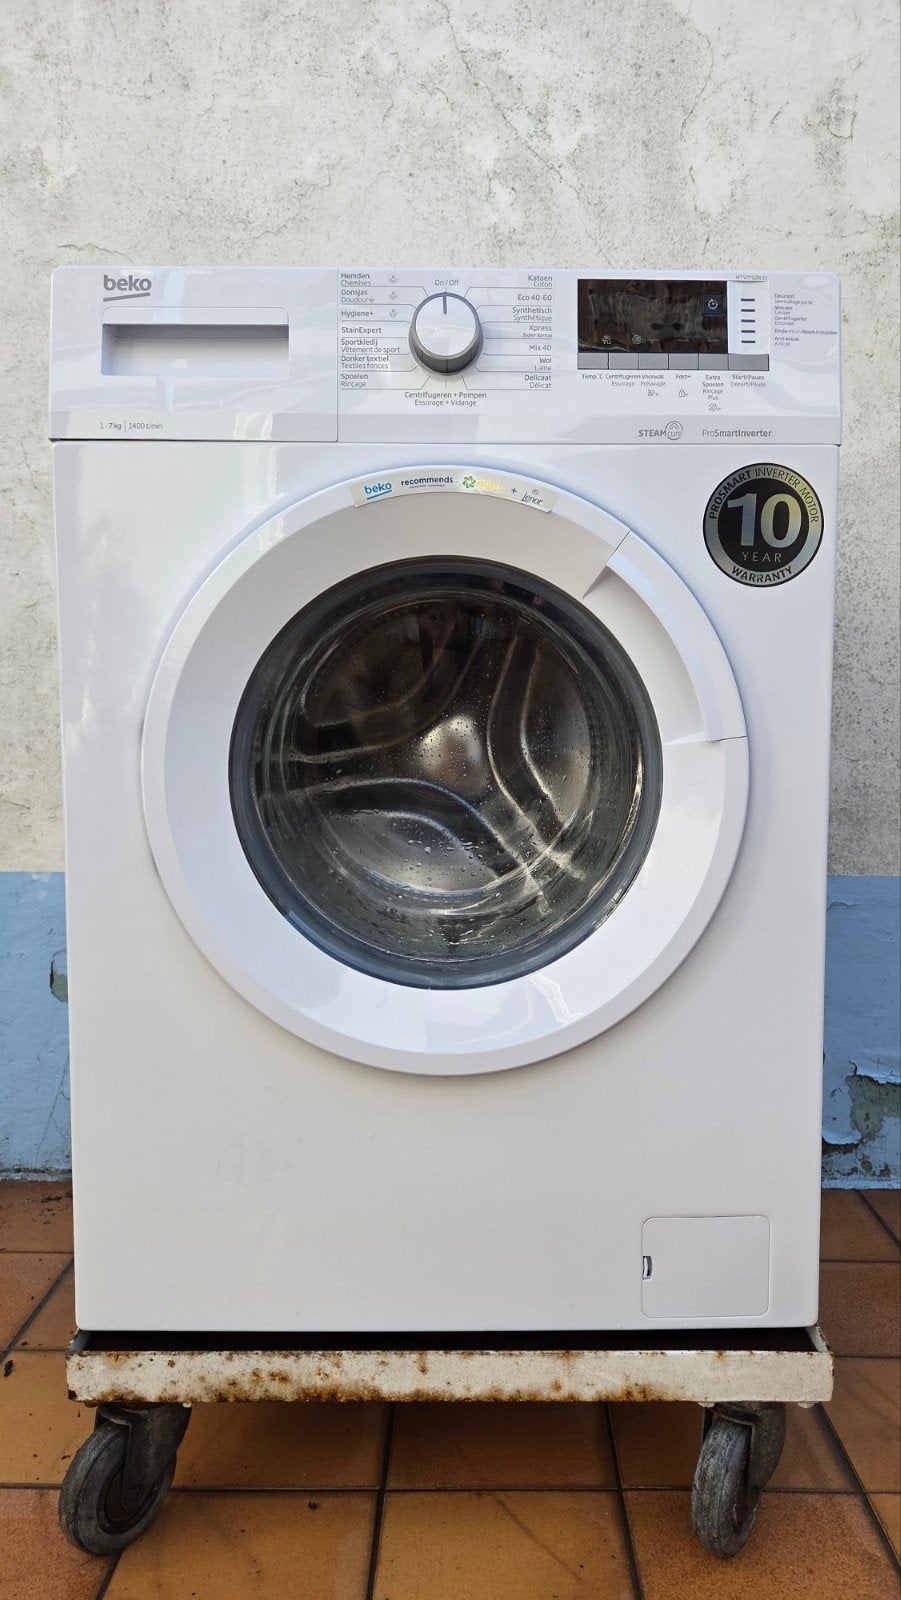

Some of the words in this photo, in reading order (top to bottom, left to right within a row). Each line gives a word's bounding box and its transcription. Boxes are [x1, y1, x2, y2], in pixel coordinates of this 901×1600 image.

[103, 274, 152, 291] beko
[341, 289, 368, 297] Donsjas
[340, 310, 374, 318] Hygiene+
[512, 307, 552, 315] Synthetisch
[513, 314, 553, 322] Synthétique
[341, 327, 382, 335] StainExpert
[340, 339, 378, 347] Sportkledij
[383, 347, 400, 355] sport
[404, 391, 452, 399] Centrifugeren
[458, 391, 487, 399] Pompen
[415, 399, 444, 407] Essorage
[451, 399, 477, 407] Vidange
[129, 422, 145, 430] 1400
[702, 429, 772, 437] ProSmartInverter
[364, 482, 393, 495] beko
[400, 476, 454, 487] recommends
[521, 492, 543, 505] Lenor
[709, 470, 752, 520] PROSMART
[755, 467, 801, 489] INVERTER
[799, 487, 820, 523] MOTOR
[727, 493, 802, 548] 10
[741, 551, 782, 563] YEAR
[732, 565, 793, 583] WARRANTY
